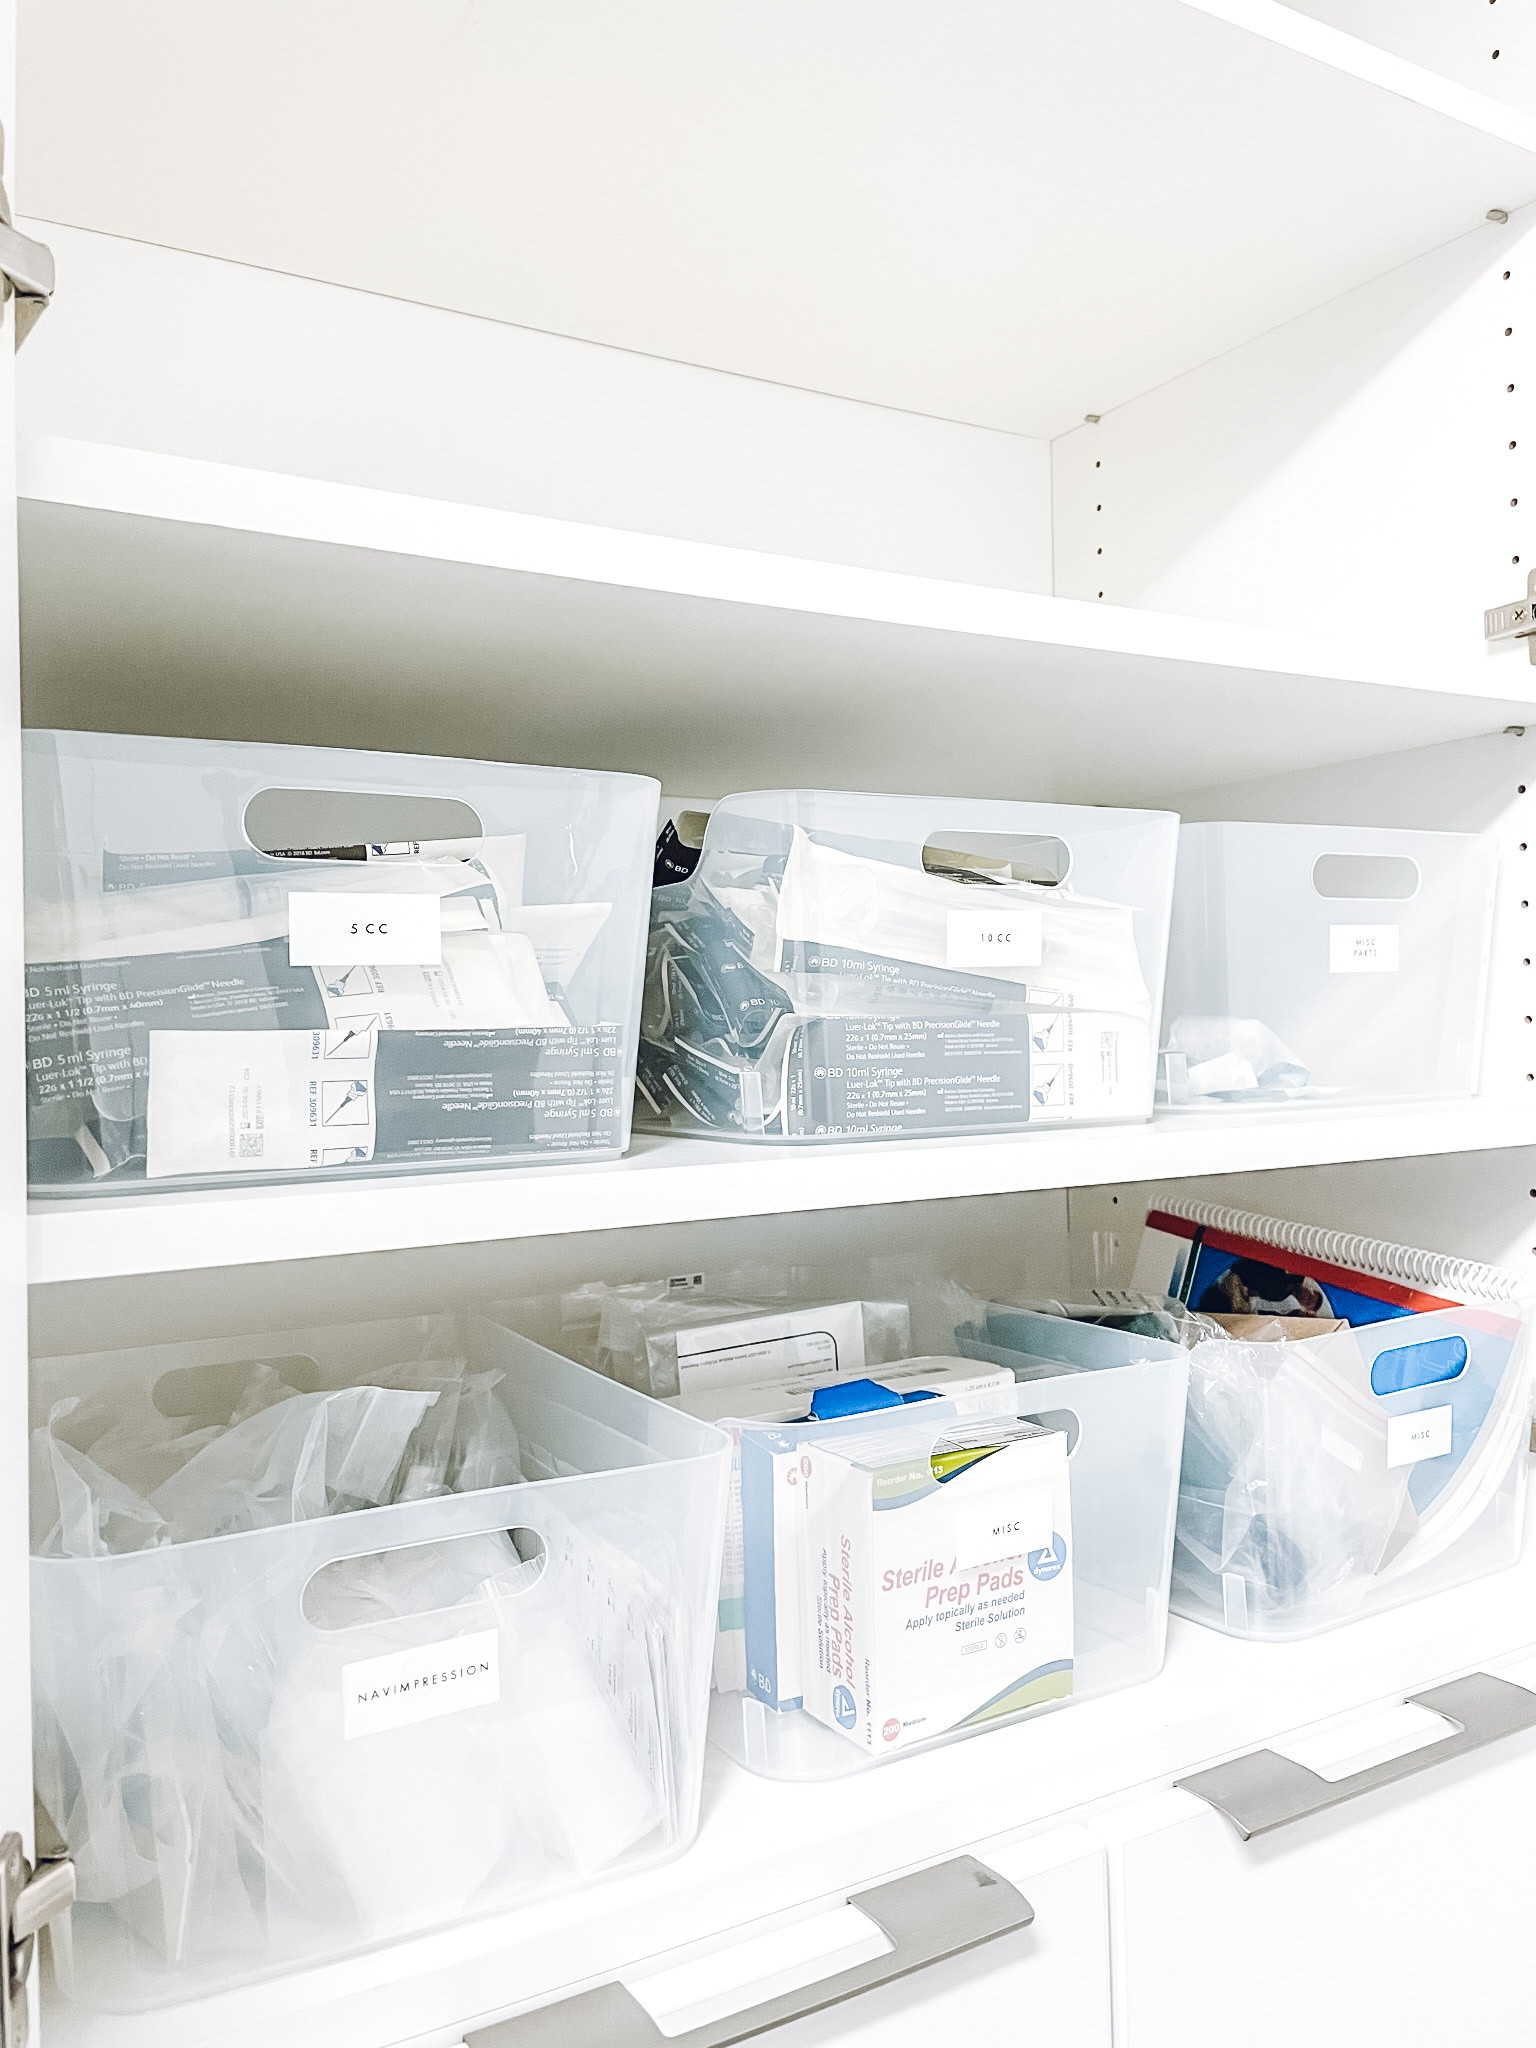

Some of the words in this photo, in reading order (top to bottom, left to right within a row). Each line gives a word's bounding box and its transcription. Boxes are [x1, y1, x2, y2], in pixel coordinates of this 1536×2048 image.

[674, 865, 688, 874] BD
[1356, 938, 1376, 946] MISC
[1353, 949, 1377, 957] PARTS
[821, 958, 839, 968] BD
[842, 958, 865, 970] 10ml
[867, 960, 900, 976] Syringe
[72, 982, 118, 995] Syringe
[77, 996, 93, 1006] Tip
[95, 993, 117, 1003] with
[120, 992, 134, 1000] BD
[211, 978, 245, 989] Needle
[384, 1012, 395, 1029] 9631
[882, 1022, 894, 1032] Tip
[895, 1020, 911, 1030] with
[912, 1021, 923, 1029] BD
[976, 1019, 1000, 1028] Needle
[443, 1040, 473, 1048] Needle
[536, 1038, 548, 1046] BD
[549, 1038, 566, 1046] with
[904, 1032, 927, 1041] 25mm)
[312, 1031, 320, 1060] 309631
[545, 1046, 579, 1058] Syringe
[602, 1047, 616, 1056] BD
[32, 1057, 53, 1070] BD
[86, 1047, 132, 1062] Syringe
[89, 1063, 106, 1074] Tip
[108, 1060, 131, 1070] with
[133, 1056, 148, 1066] BD
[827, 1068, 844, 1078] BD
[846, 1067, 870, 1078] 10ml
[871, 1066, 904, 1079] Syringe
[309, 1081, 318, 1096] REF
[884, 1078, 895, 1089] Tip
[896, 1078, 911, 1086] with
[912, 1077, 923, 1086] BD
[976, 1074, 1000, 1083] Needle
[904, 1088, 927, 1098] 25mm)
[441, 1102, 472, 1112] Needle
[534, 1100, 546, 1108] BD
[547, 1099, 564, 1108] with
[566, 1098, 576, 1108] Tip
[309, 1097, 318, 1127] 309631
[544, 1107, 578, 1119] Syringe
[600, 1108, 614, 1118] BD
[827, 1126, 843, 1134] BD
[310, 1149, 318, 1163] REF
[876, 1474, 907, 1487] Reorder
[909, 1469, 924, 1481] No.
[992, 1521, 1020, 1536] MISC
[840, 1534, 852, 1601] Sterile
[882, 1558, 944, 1592] Sterile
[925, 1582, 970, 1609] Prep
[976, 1566, 1024, 1595] Pads
[828, 1572, 841, 1622] Prep
[905, 1615, 932, 1631] Apply
[936, 1602, 975, 1622] topically
[978, 1601, 988, 1611] as
[991, 1590, 1025, 1608] needed
[955, 1616, 985, 1632] Sterile
[988, 1606, 1026, 1624] Solution
[830, 1626, 842, 1679] Pads
[844, 1604, 856, 1690] Alcohol
[358, 1662, 489, 1703] NAVIMPRESSION
[758, 1672, 772, 1694] BD
[883, 1723, 900, 1736] 200
[903, 1716, 927, 1728] Medium
